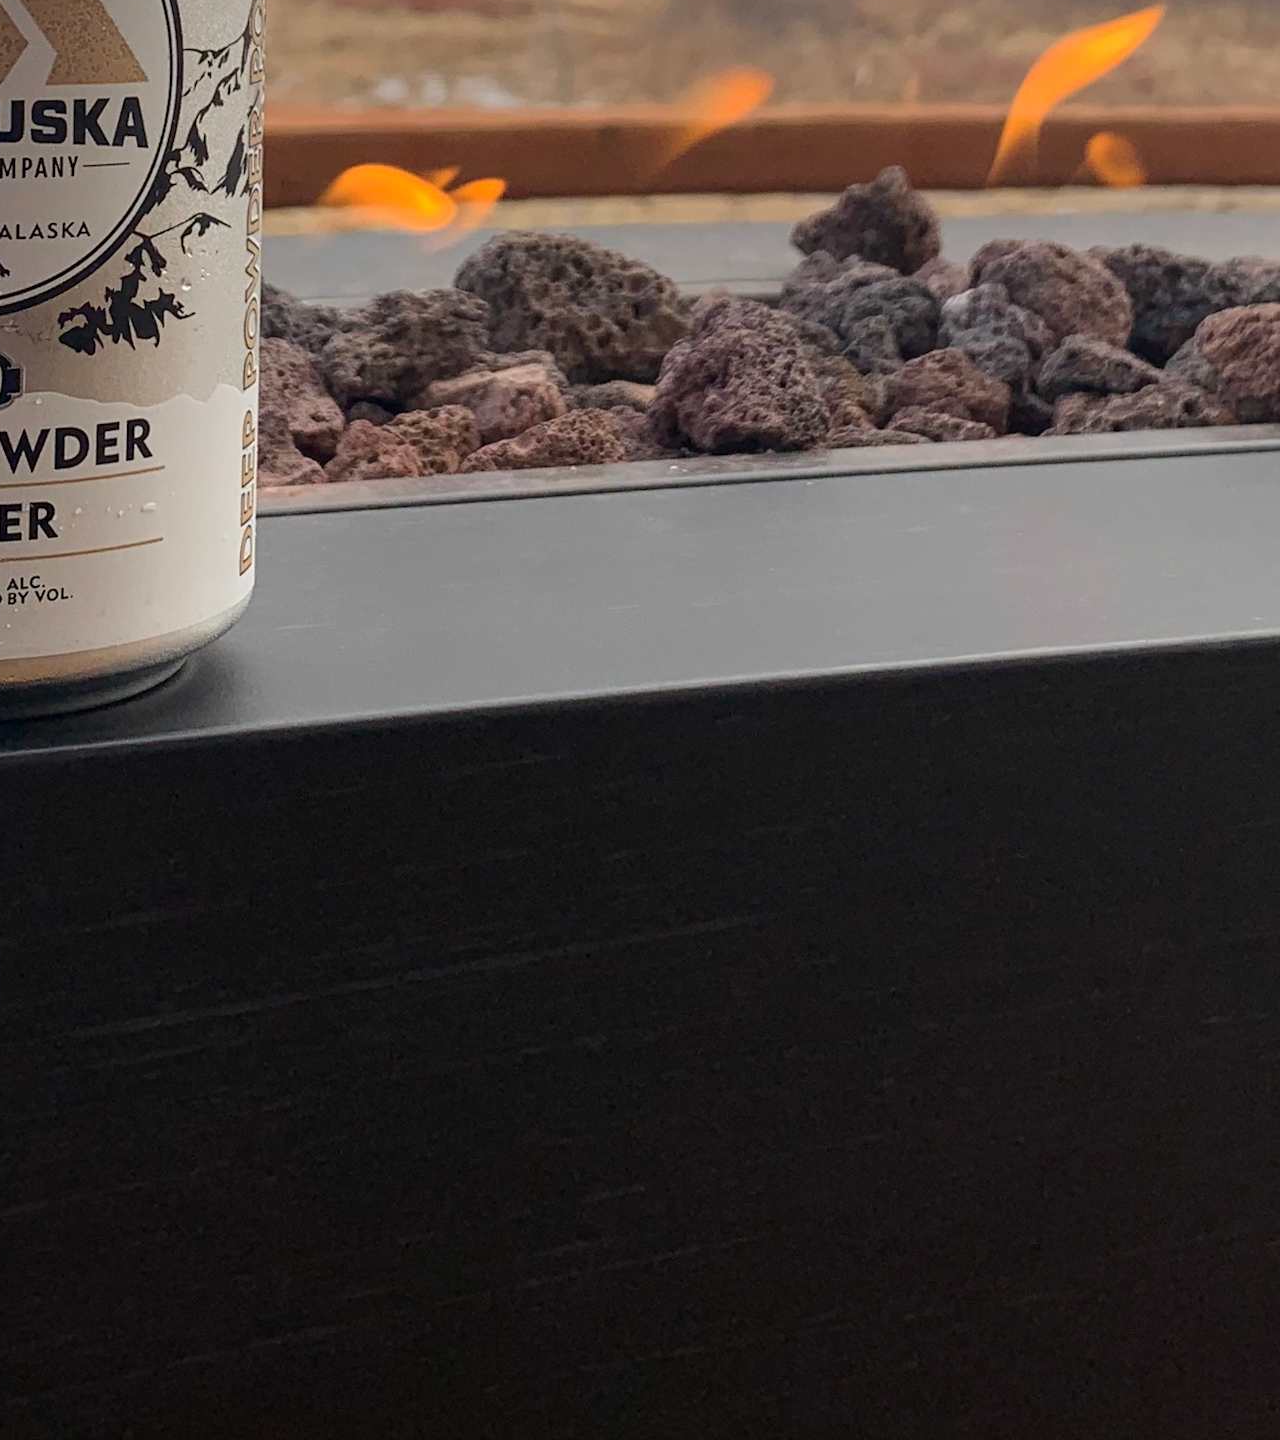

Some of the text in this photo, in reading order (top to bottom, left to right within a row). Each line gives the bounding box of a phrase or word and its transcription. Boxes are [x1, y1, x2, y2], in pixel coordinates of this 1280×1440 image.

[244, 113, 265, 391] POWDER
[239, 409, 257, 577] DEEP
[6, 576, 46, 591] ALC.
[8, 587, 74, 605] BY VOL.
